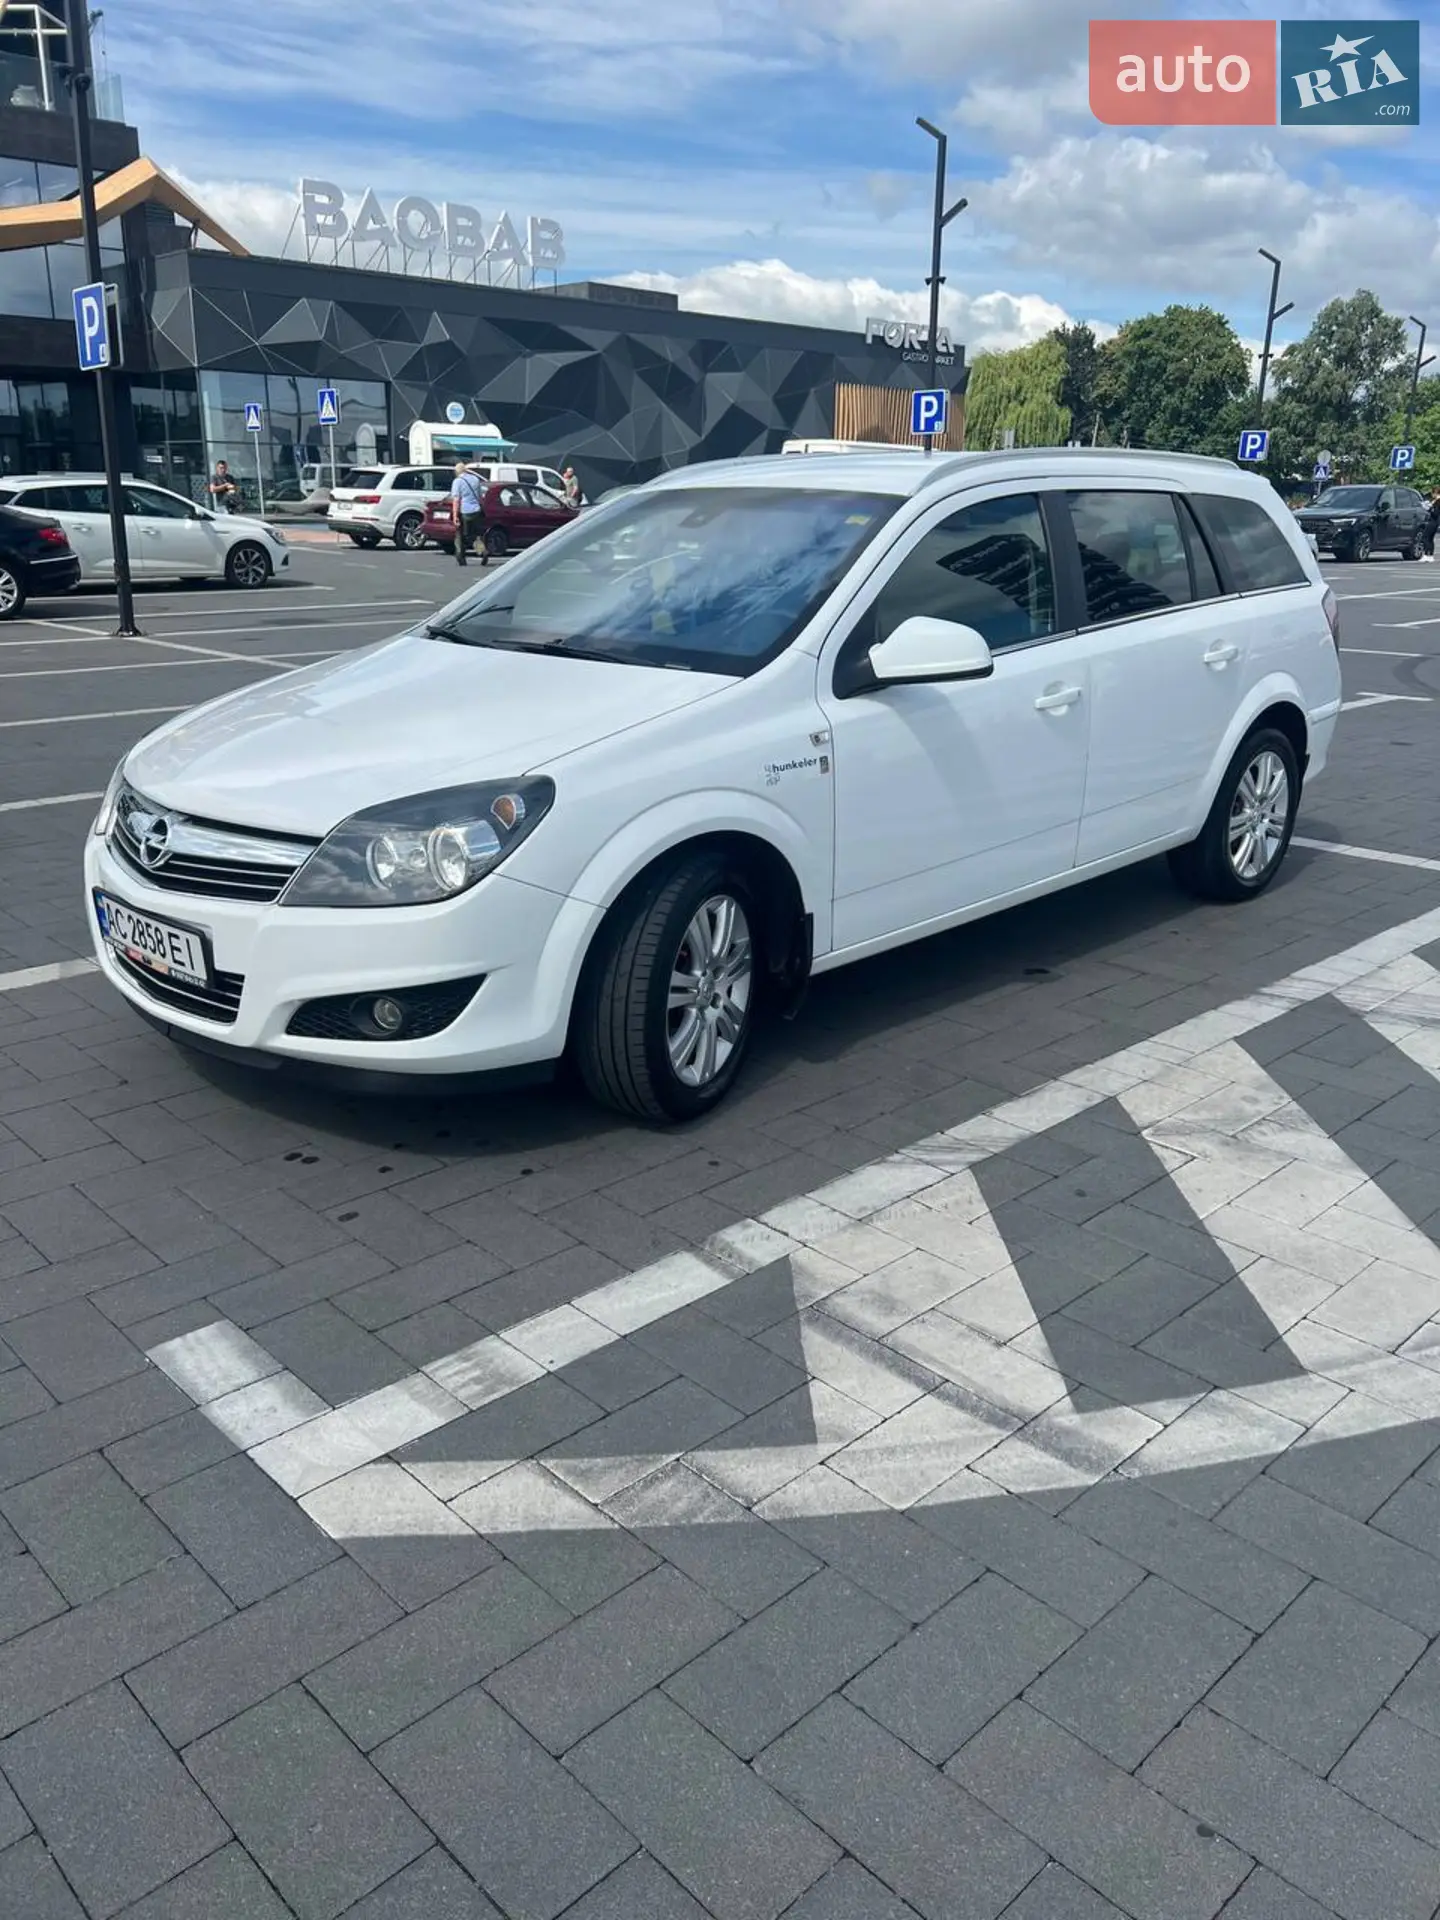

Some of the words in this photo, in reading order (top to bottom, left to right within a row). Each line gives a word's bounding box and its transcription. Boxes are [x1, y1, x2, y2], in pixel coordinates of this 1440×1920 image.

[300, 177, 566, 270] BAOBAB
[81, 296, 99, 361] P
[866, 317, 955, 353] FORA
[919, 395, 938, 431] P
[1244, 434, 1262, 458] P
[1396, 449, 1409, 468] P
[127, 914, 167, 959] 2858
